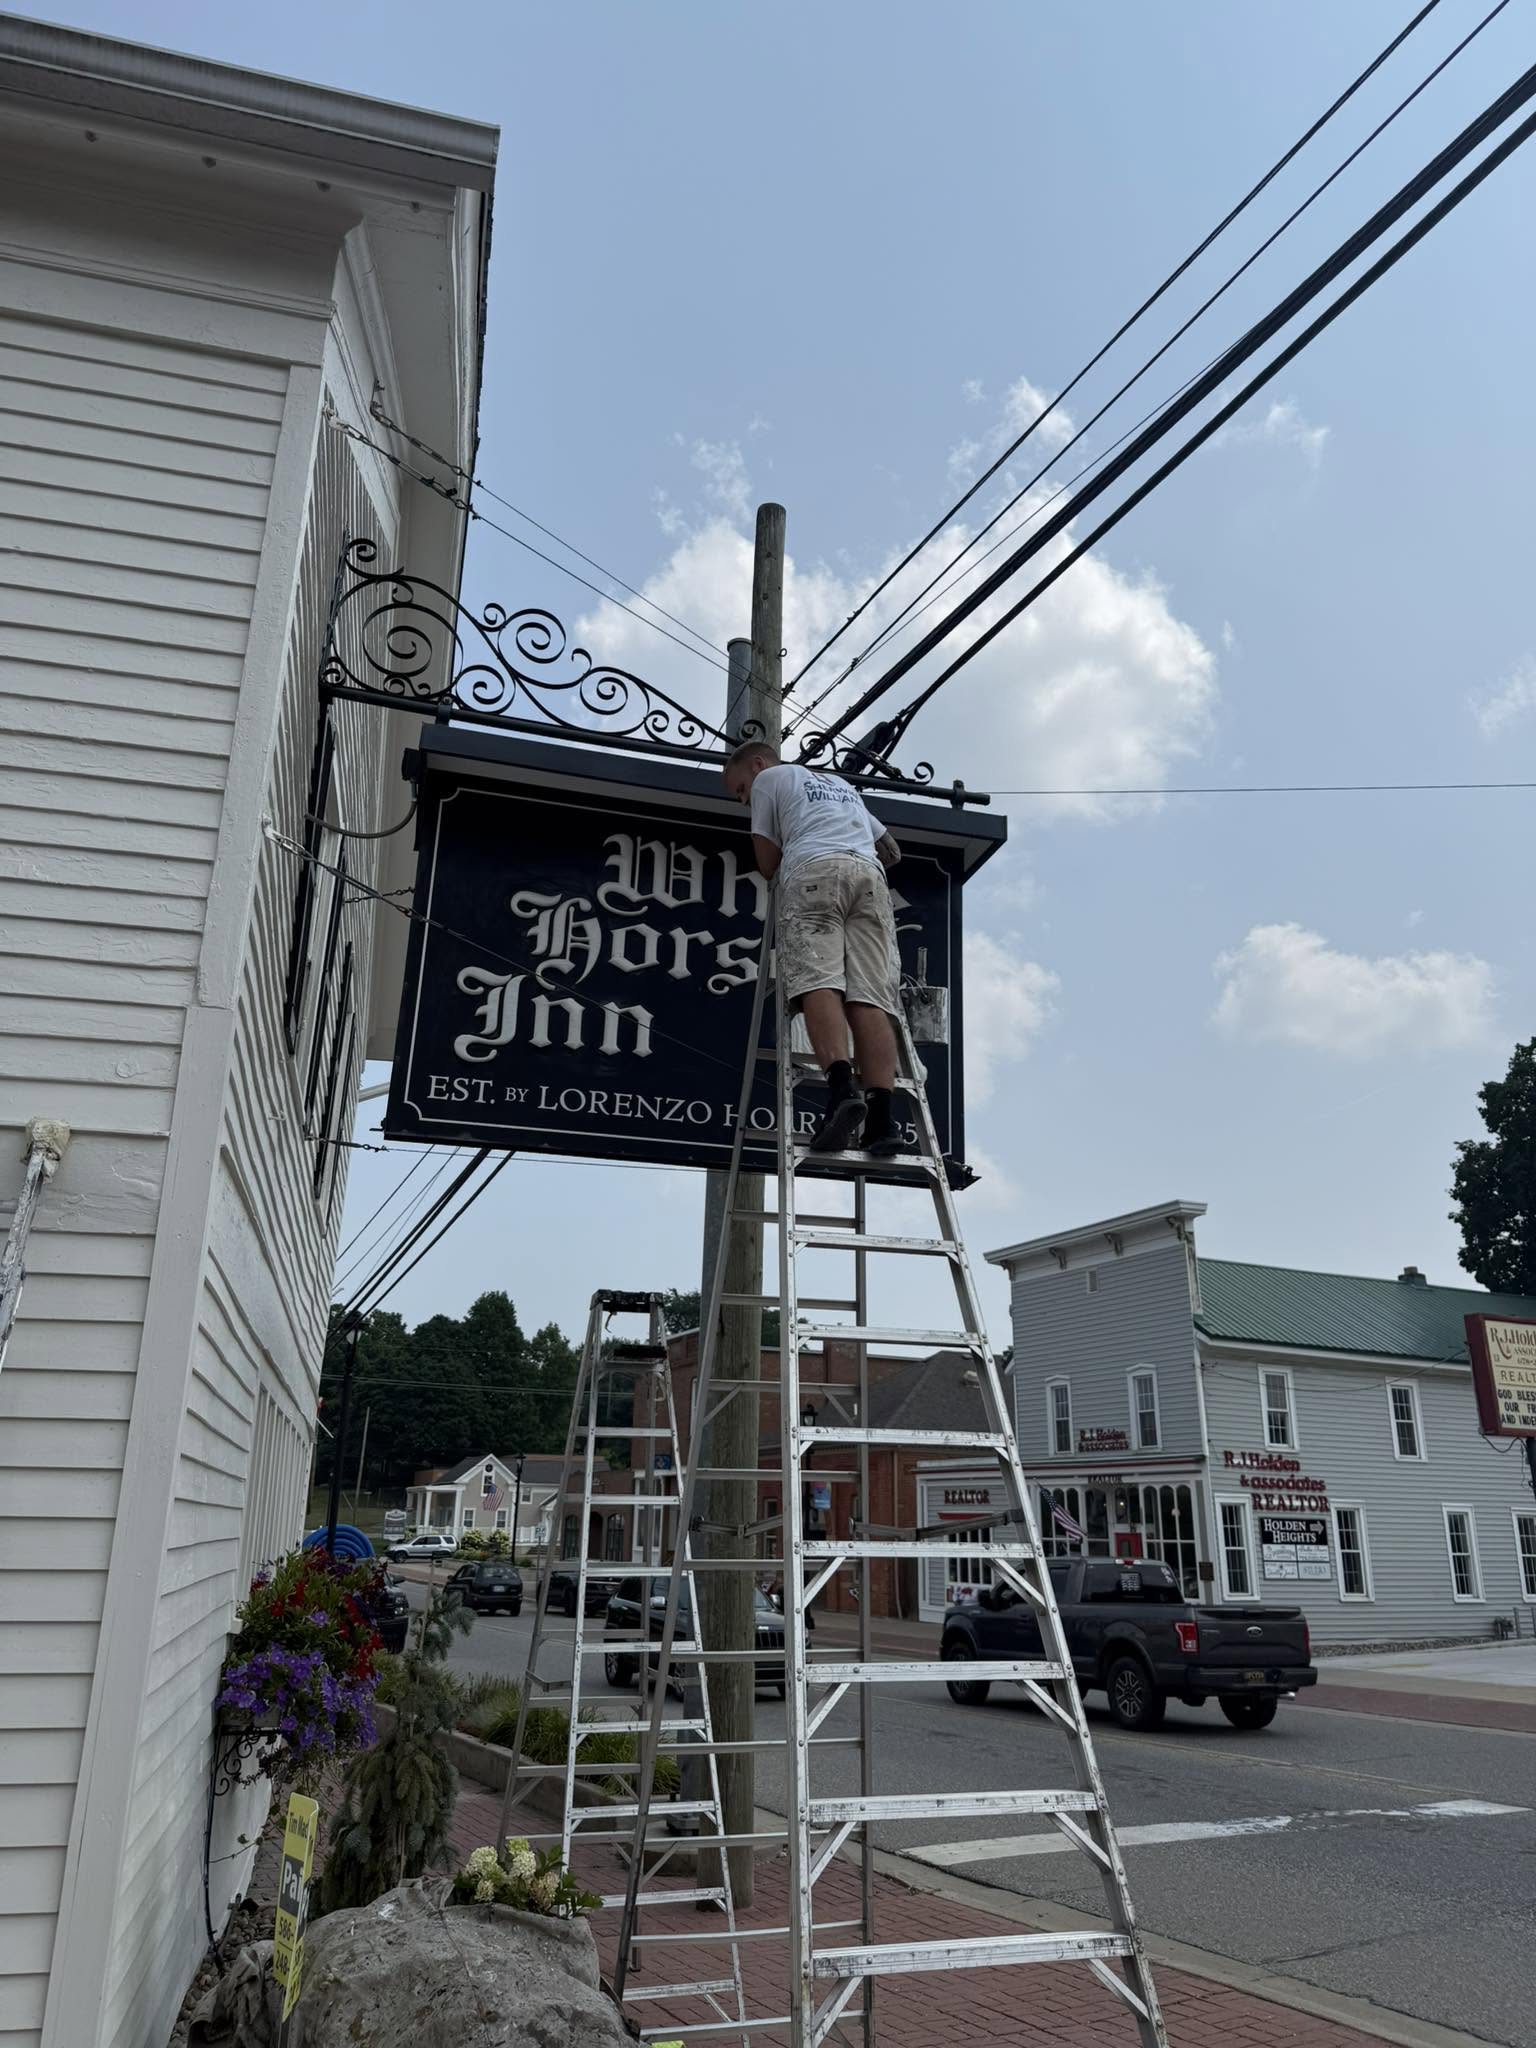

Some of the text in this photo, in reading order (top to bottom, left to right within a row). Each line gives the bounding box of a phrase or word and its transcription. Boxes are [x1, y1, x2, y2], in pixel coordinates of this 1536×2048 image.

[510, 889, 776, 995] Hors
[453, 965, 654, 1063] Inn
[426, 1075, 495, 1104] EST.
[505, 1087, 529, 1102] BY
[537, 1085, 713, 1124] LORENZO
[1497, 1389, 1513, 1400] GOD
[1504, 1401, 1520, 1412] OUR
[1500, 1413, 1516, 1425] AND
[944, 1489, 990, 1504] REALTOR
[1252, 1493, 1331, 1512] REALTOR
[1263, 1519, 1306, 1532] HOLDEN
[1272, 1530, 1317, 1543] HEIGHTS
